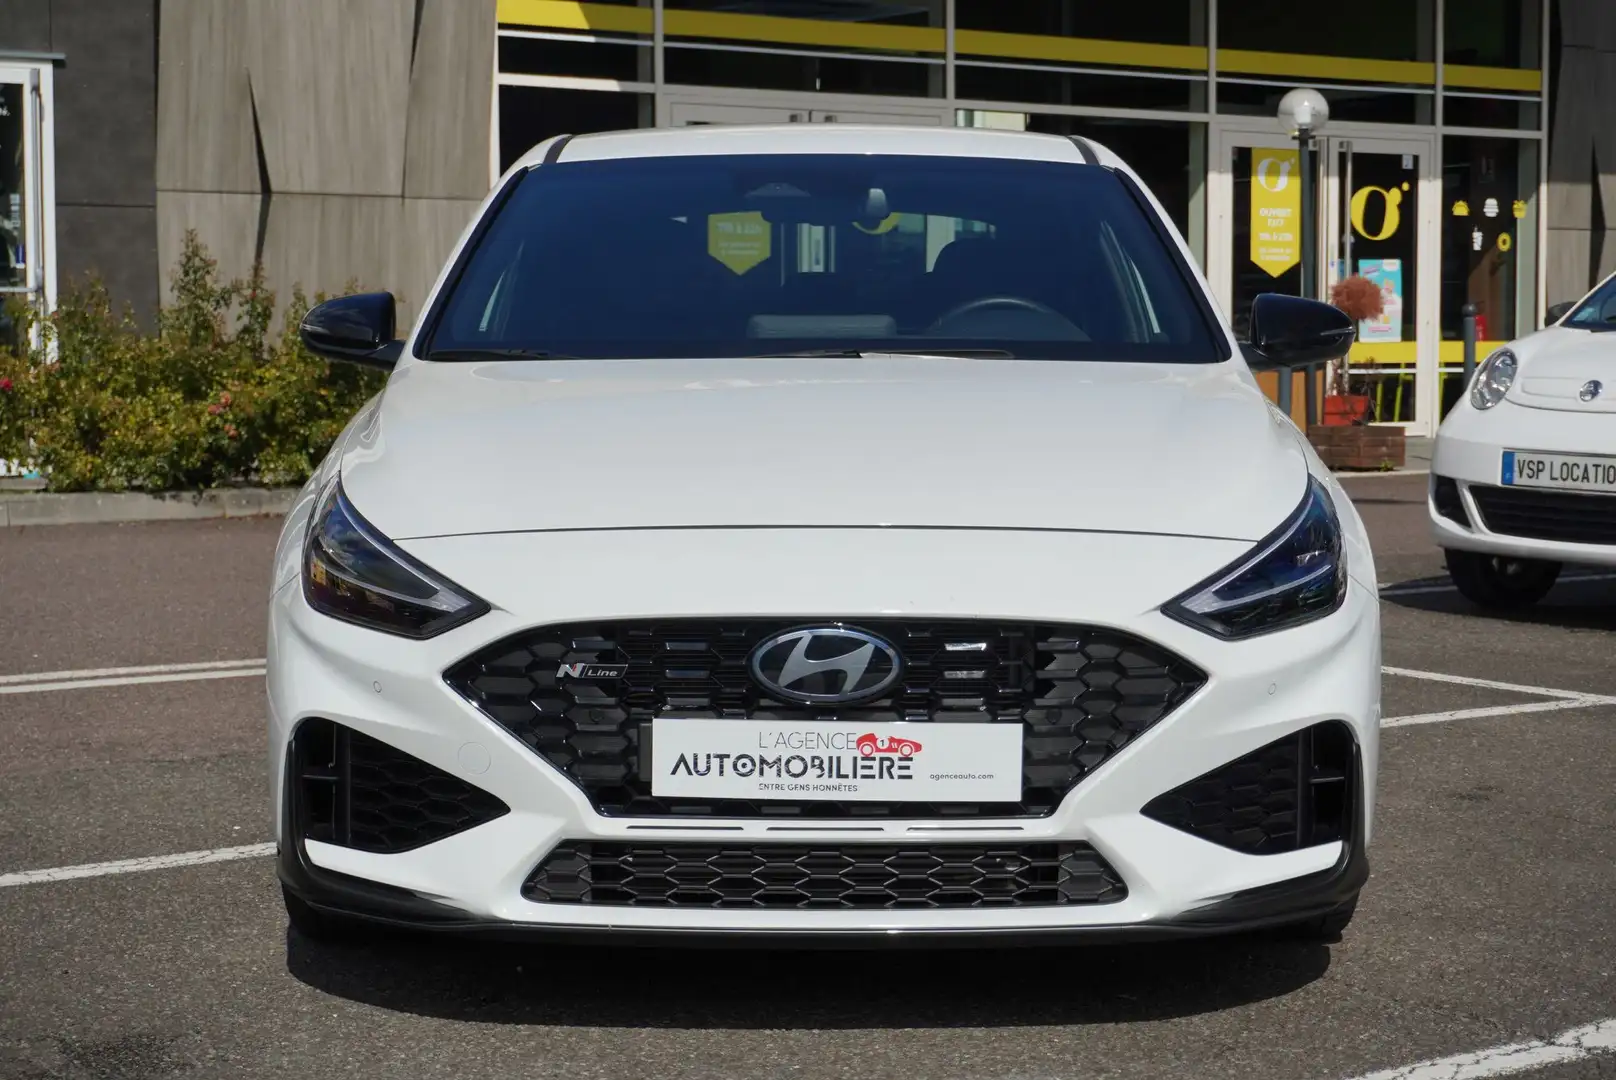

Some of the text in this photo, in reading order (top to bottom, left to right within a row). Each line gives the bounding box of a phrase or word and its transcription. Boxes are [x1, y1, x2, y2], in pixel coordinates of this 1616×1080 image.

[1517, 459, 1546, 480] VSP
[587, 669, 618, 677] Line
[758, 731, 857, 750] L'AGENCE
[929, 772, 994, 782] agenceauto.com
[758, 783, 858, 792] ENTRE GENS HONNÊTES
